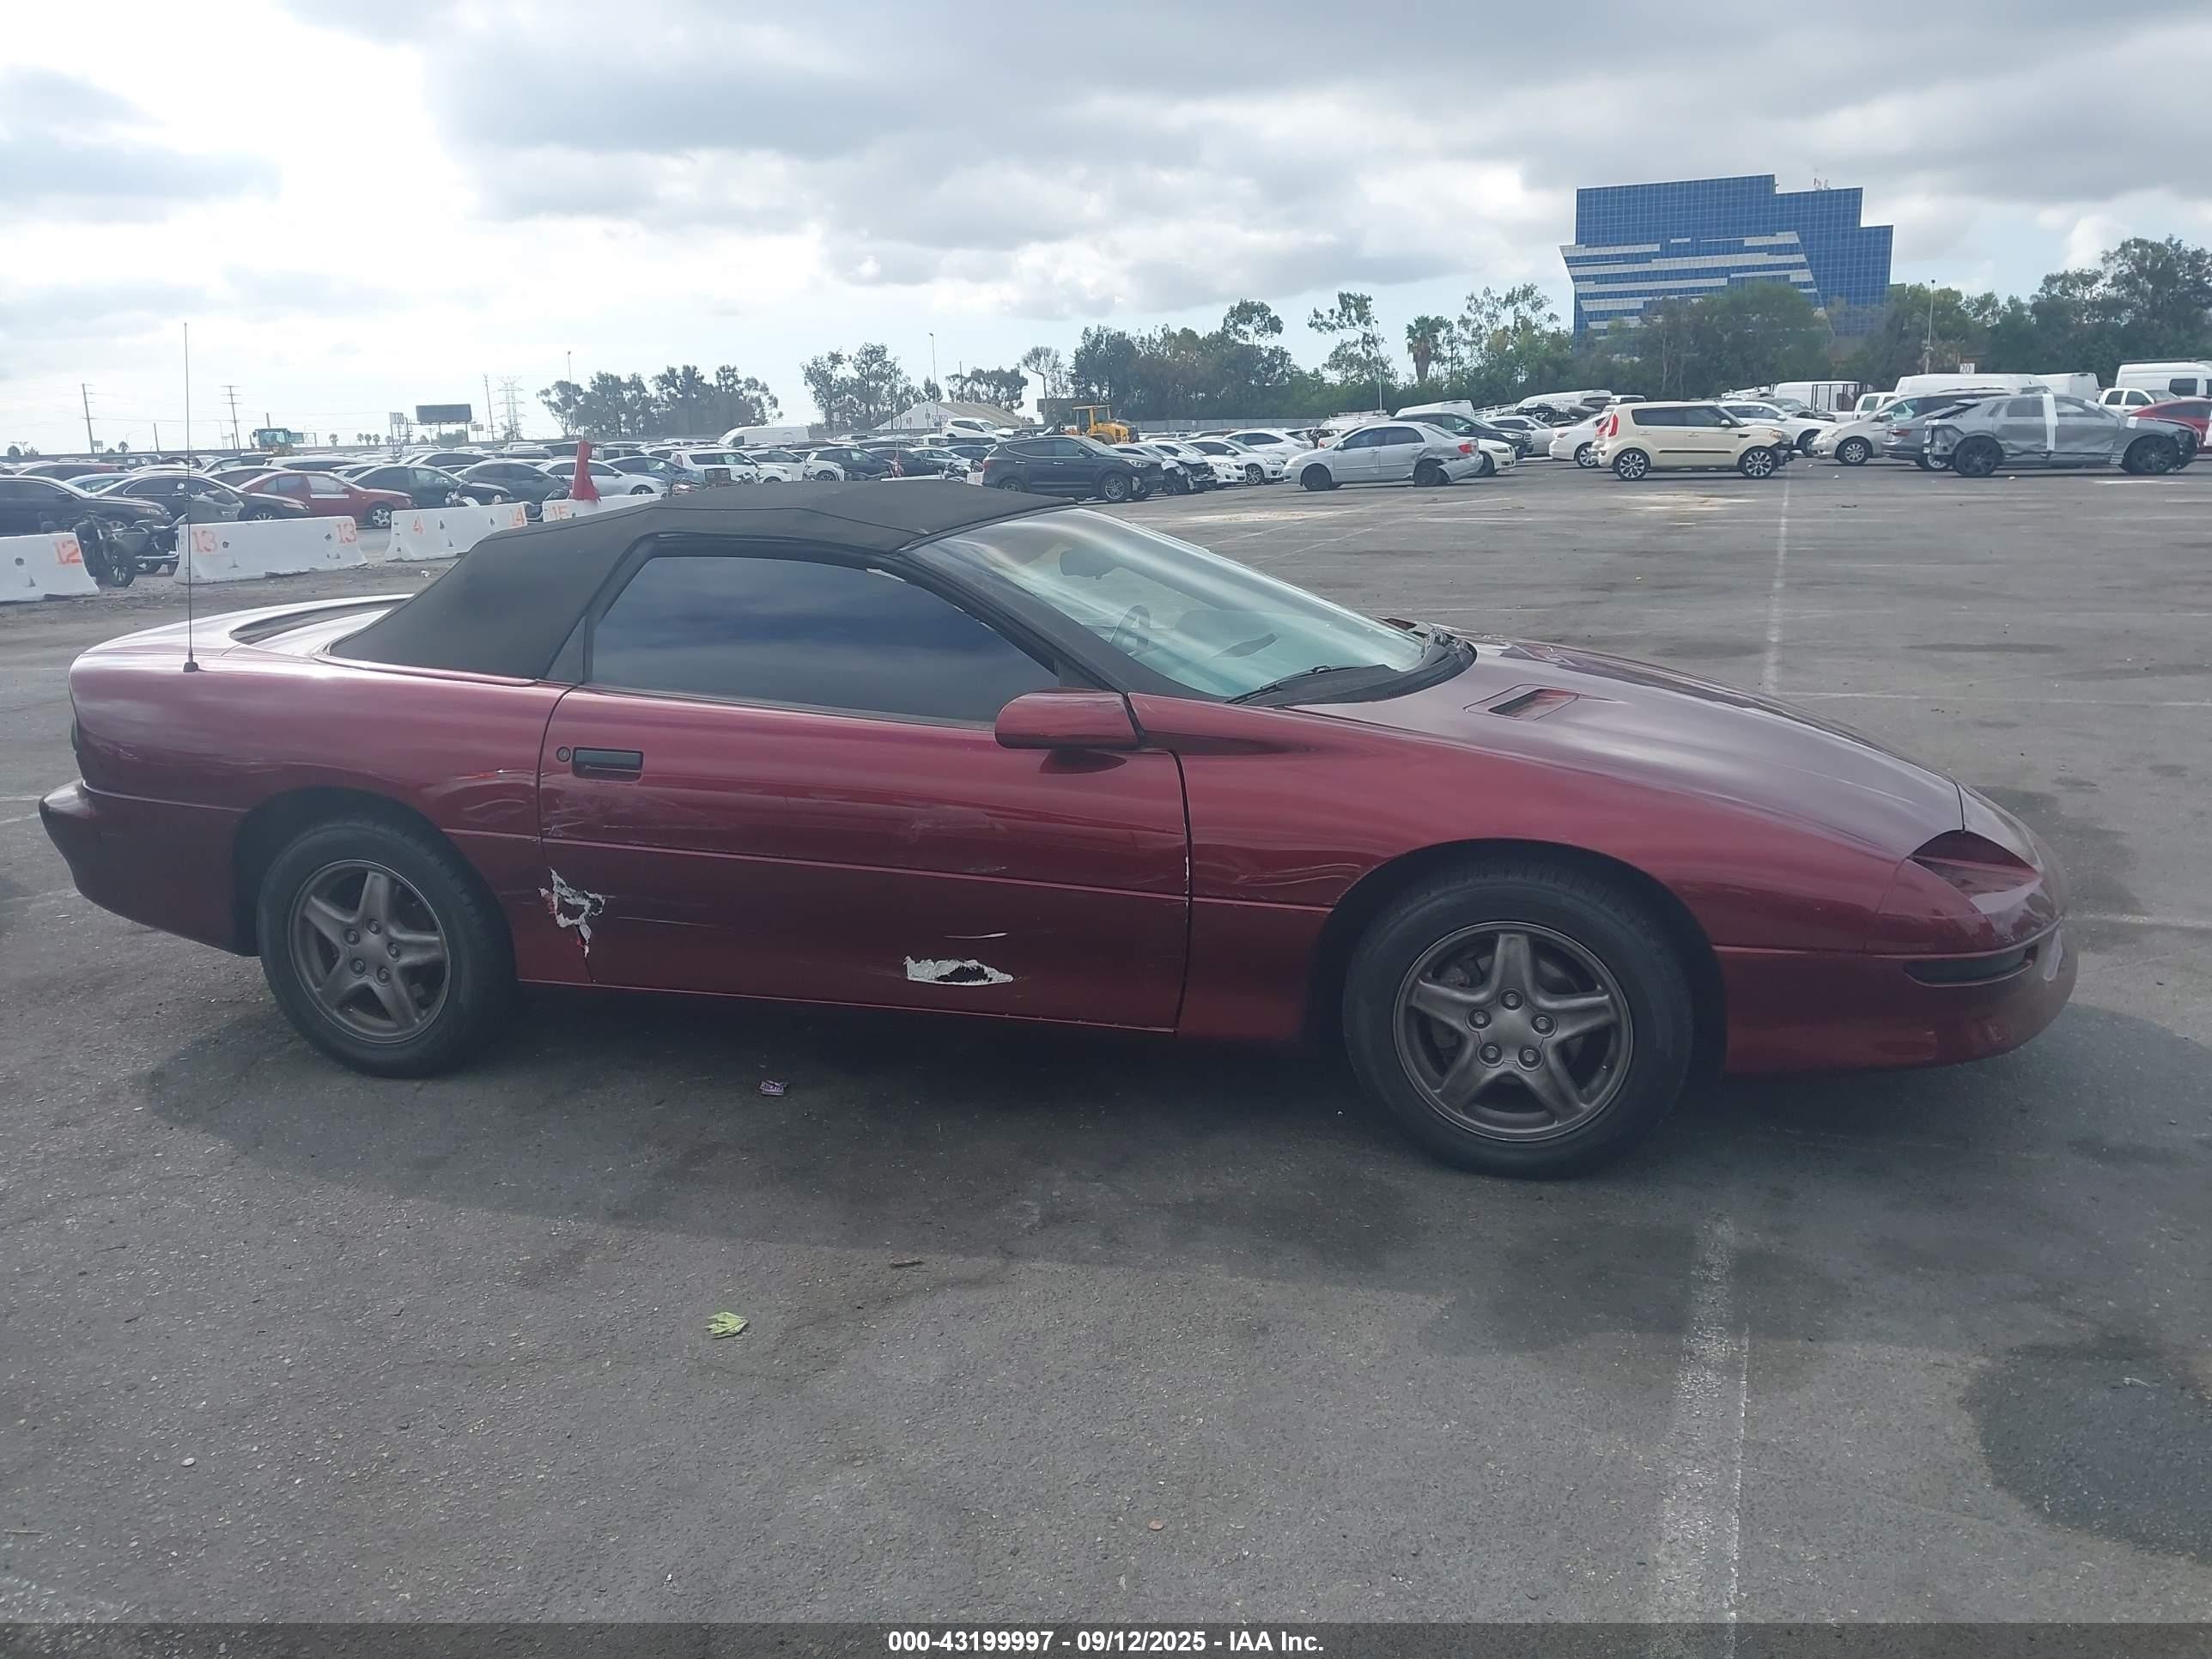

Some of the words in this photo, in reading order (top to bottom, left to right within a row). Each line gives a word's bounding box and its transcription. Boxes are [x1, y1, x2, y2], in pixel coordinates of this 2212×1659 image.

[192, 530, 218, 552] 13
[336, 522, 357, 544] 13
[54, 539, 83, 565] 12
